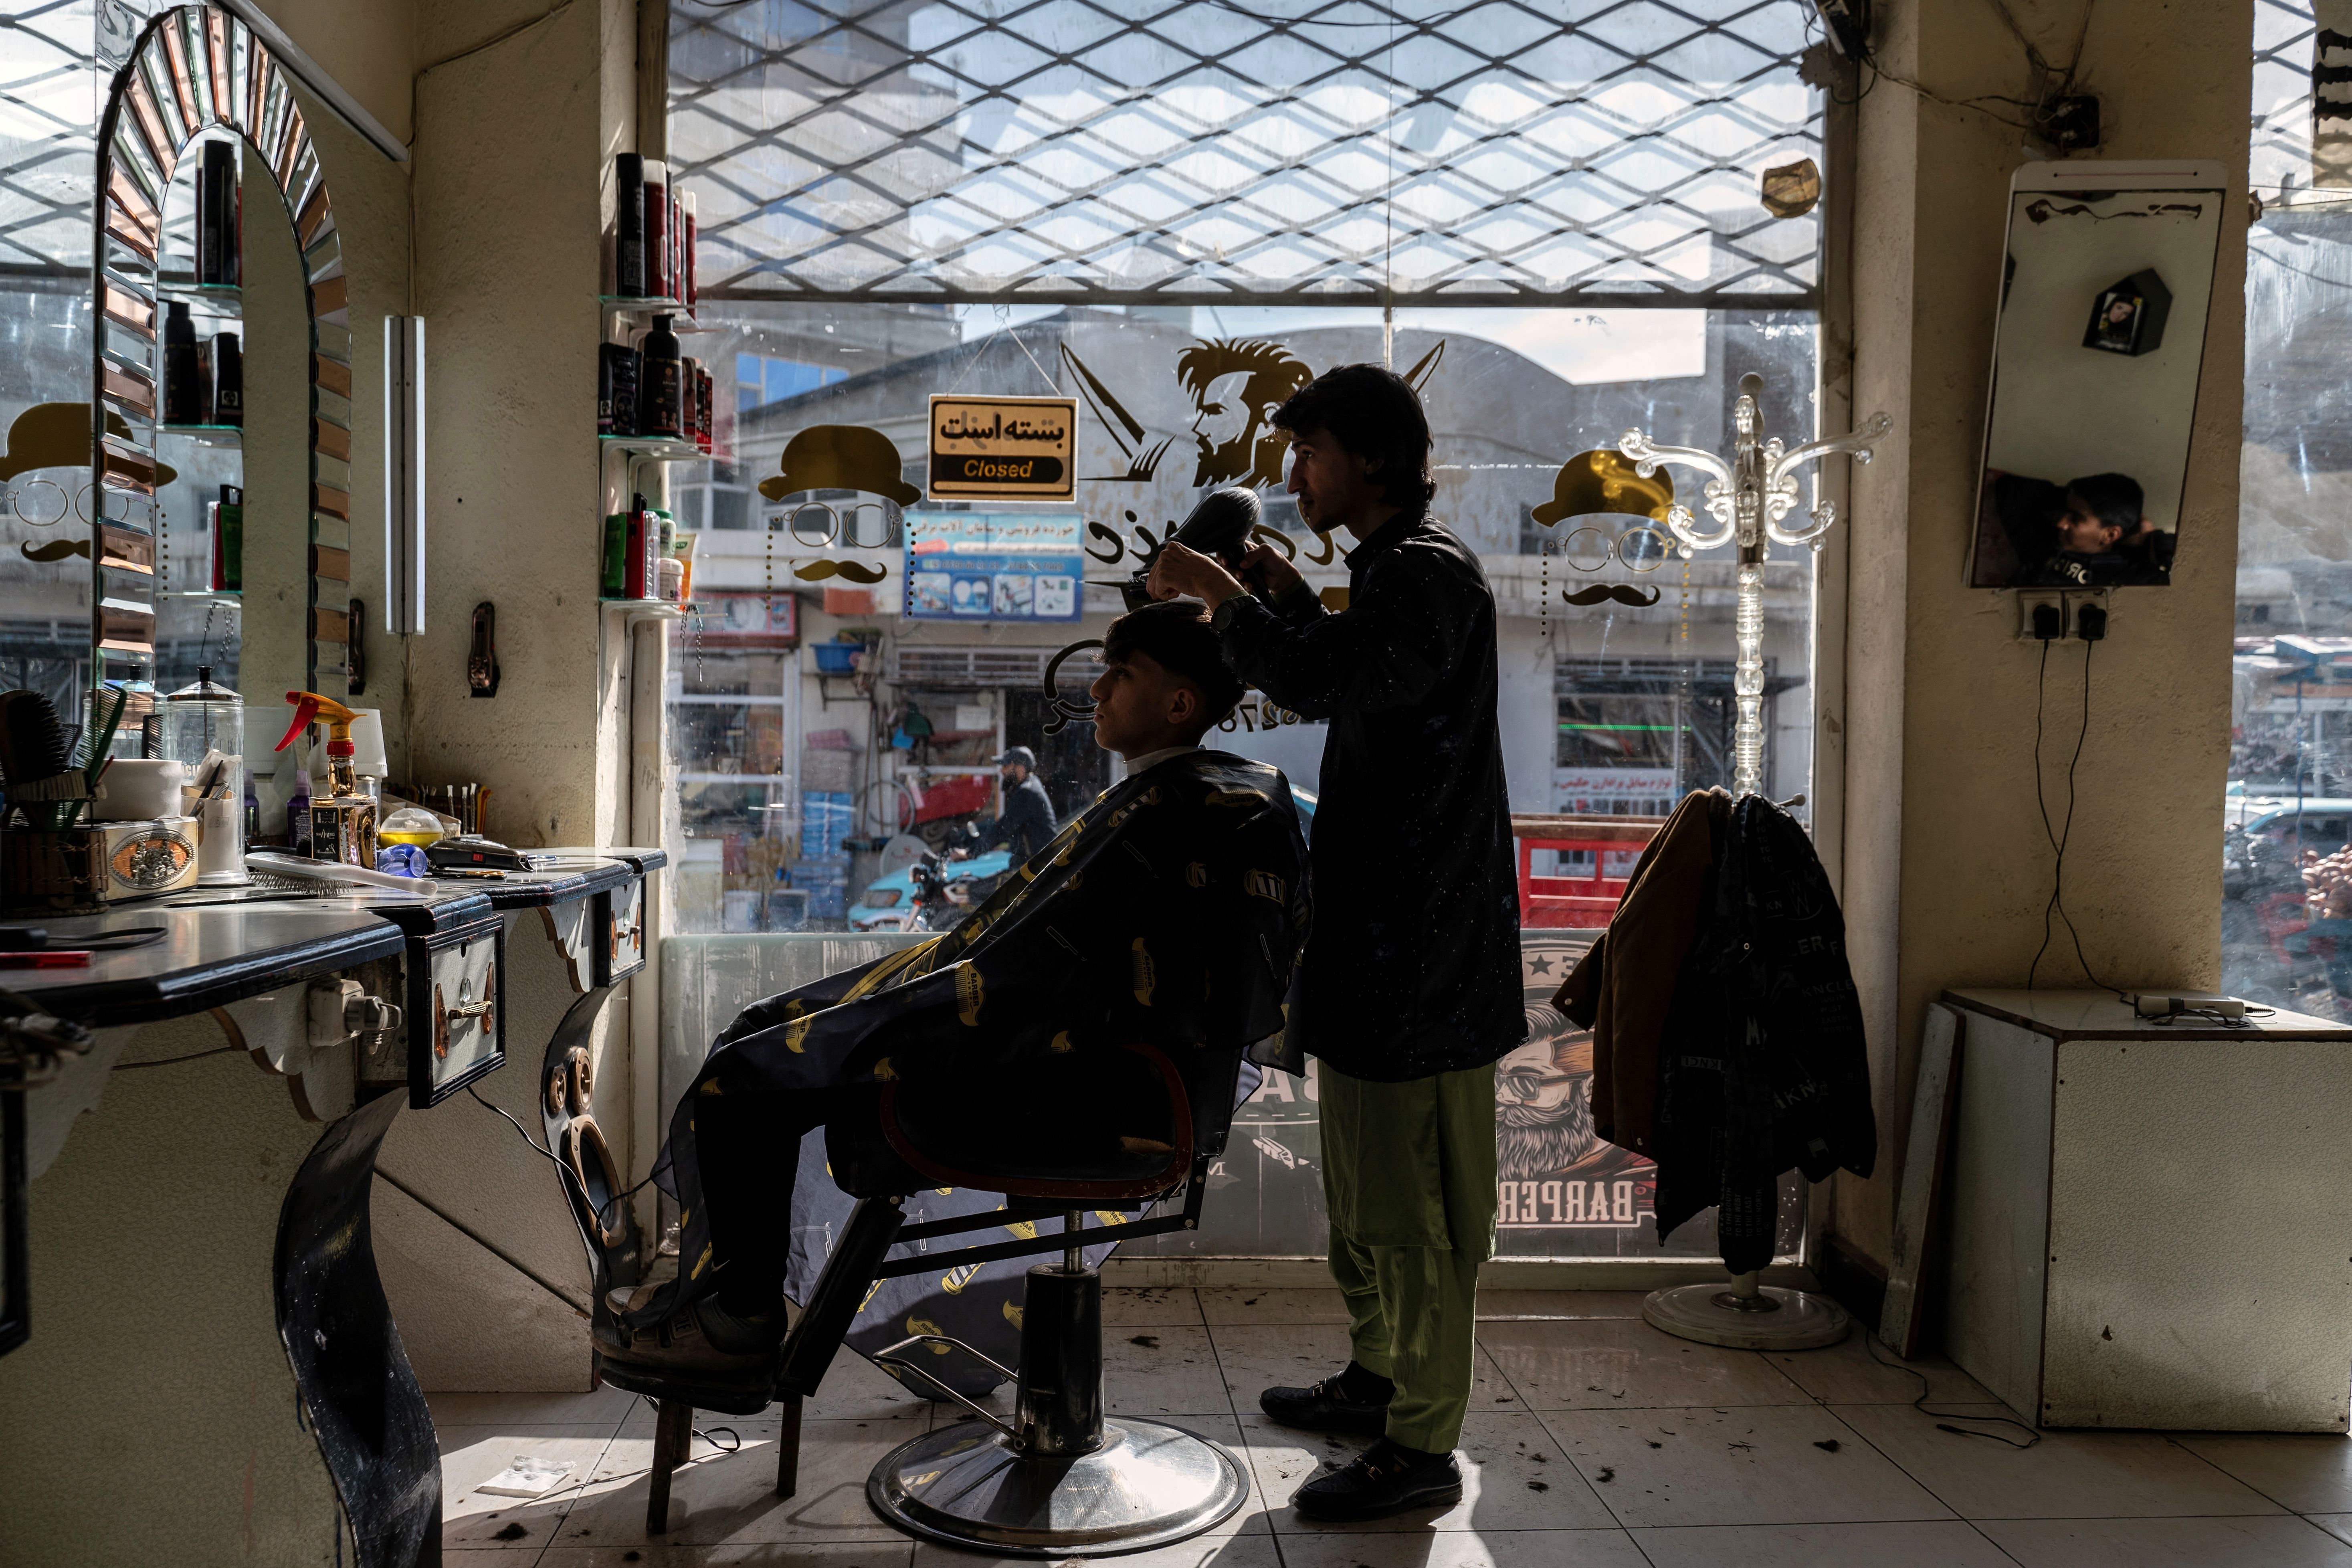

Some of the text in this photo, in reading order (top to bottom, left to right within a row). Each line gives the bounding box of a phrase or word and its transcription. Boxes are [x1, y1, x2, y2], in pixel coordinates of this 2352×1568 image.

[940, 414, 1065, 449] بسته است
[964, 460, 1033, 478] Closed
[971, 973, 979, 1006] BARBER
